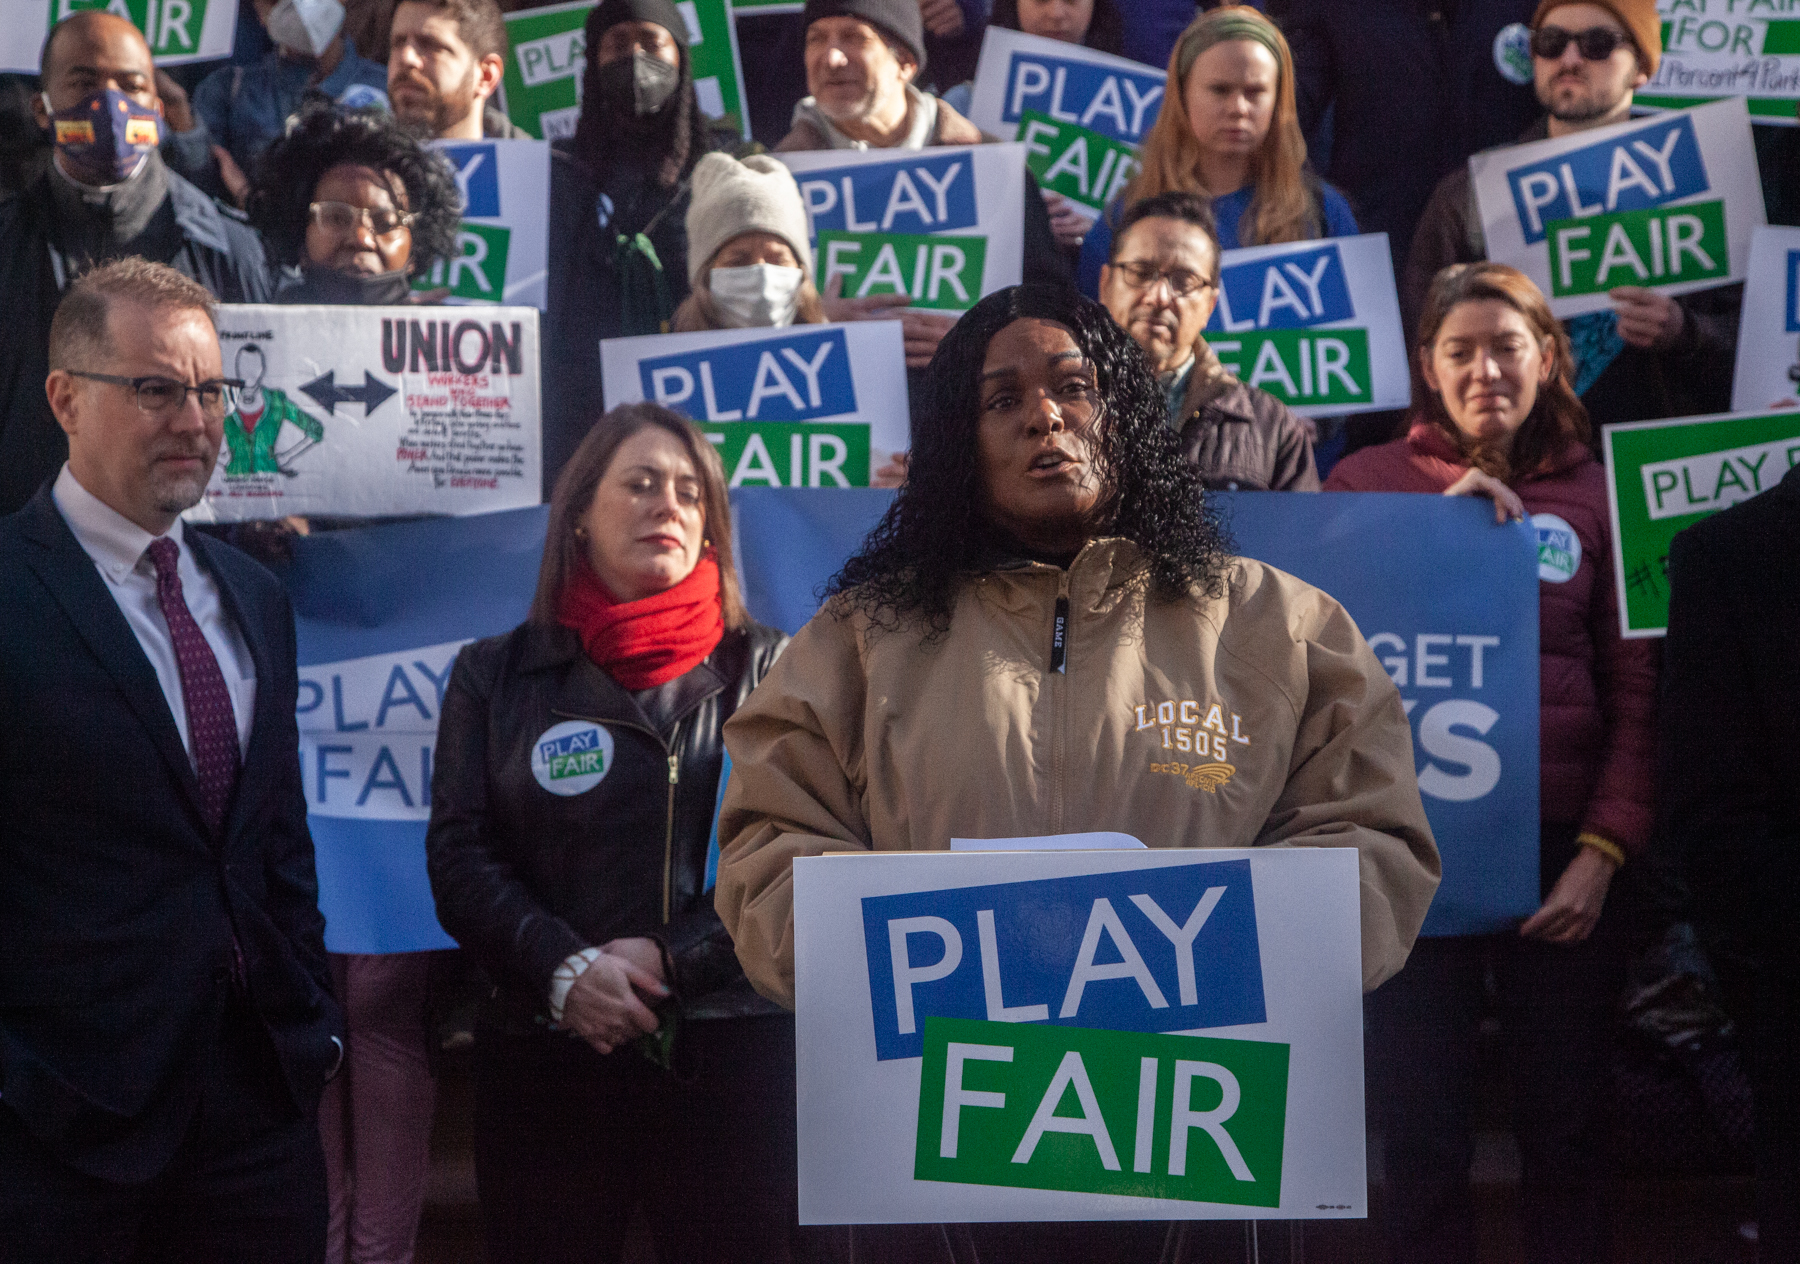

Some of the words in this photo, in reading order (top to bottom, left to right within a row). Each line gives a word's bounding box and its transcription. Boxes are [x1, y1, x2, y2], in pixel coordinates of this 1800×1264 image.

[523, 36, 586, 77] PLA
[1677, 16, 1753, 56] FOR
[1011, 62, 1164, 136] PLAY
[801, 162, 962, 238] PLAY
[1519, 127, 1682, 234] PLAY
[826, 239, 970, 302] FAIR
[1557, 213, 1717, 288] FAIR
[1219, 255, 1331, 332] LAY
[381, 317, 523, 375] UNION
[652, 341, 834, 422] PLAY
[705, 433, 851, 488] AIR
[1652, 452, 1768, 510] PLAY
[1054, 616, 1064, 648] GAME
[543, 732, 593, 763] PLAY
[1133, 700, 1251, 746] LOCAL
[1161, 725, 1227, 763] 1505
[317, 745, 431, 807] FAI
[552, 753, 600, 777] FAIR
[887, 885, 1228, 1035] PLAY
[940, 1041, 1256, 1183] FAIR
